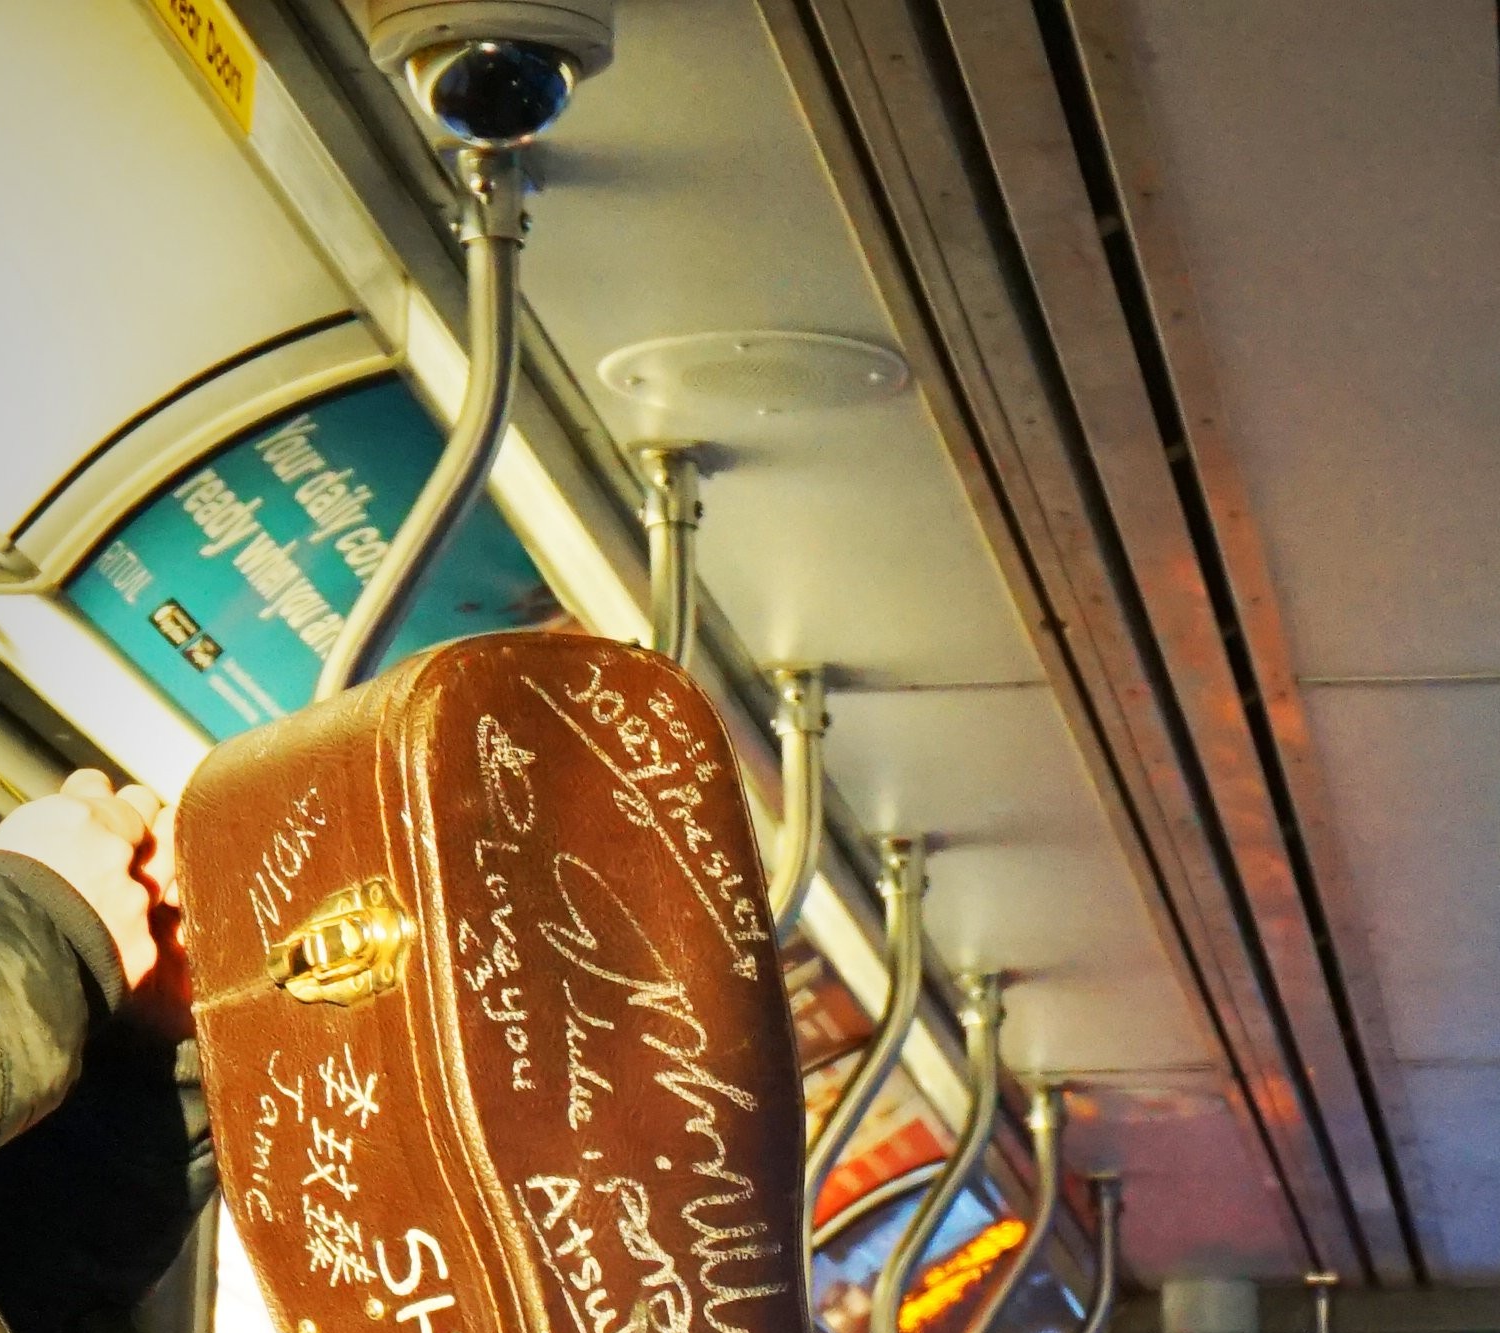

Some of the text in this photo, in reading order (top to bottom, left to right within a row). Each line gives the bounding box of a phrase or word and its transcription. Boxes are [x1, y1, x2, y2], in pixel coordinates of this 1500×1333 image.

[172, 467, 265, 559] ready
[257, 575, 333, 630] you
[254, 413, 327, 484] Your
[293, 467, 375, 546] daily
